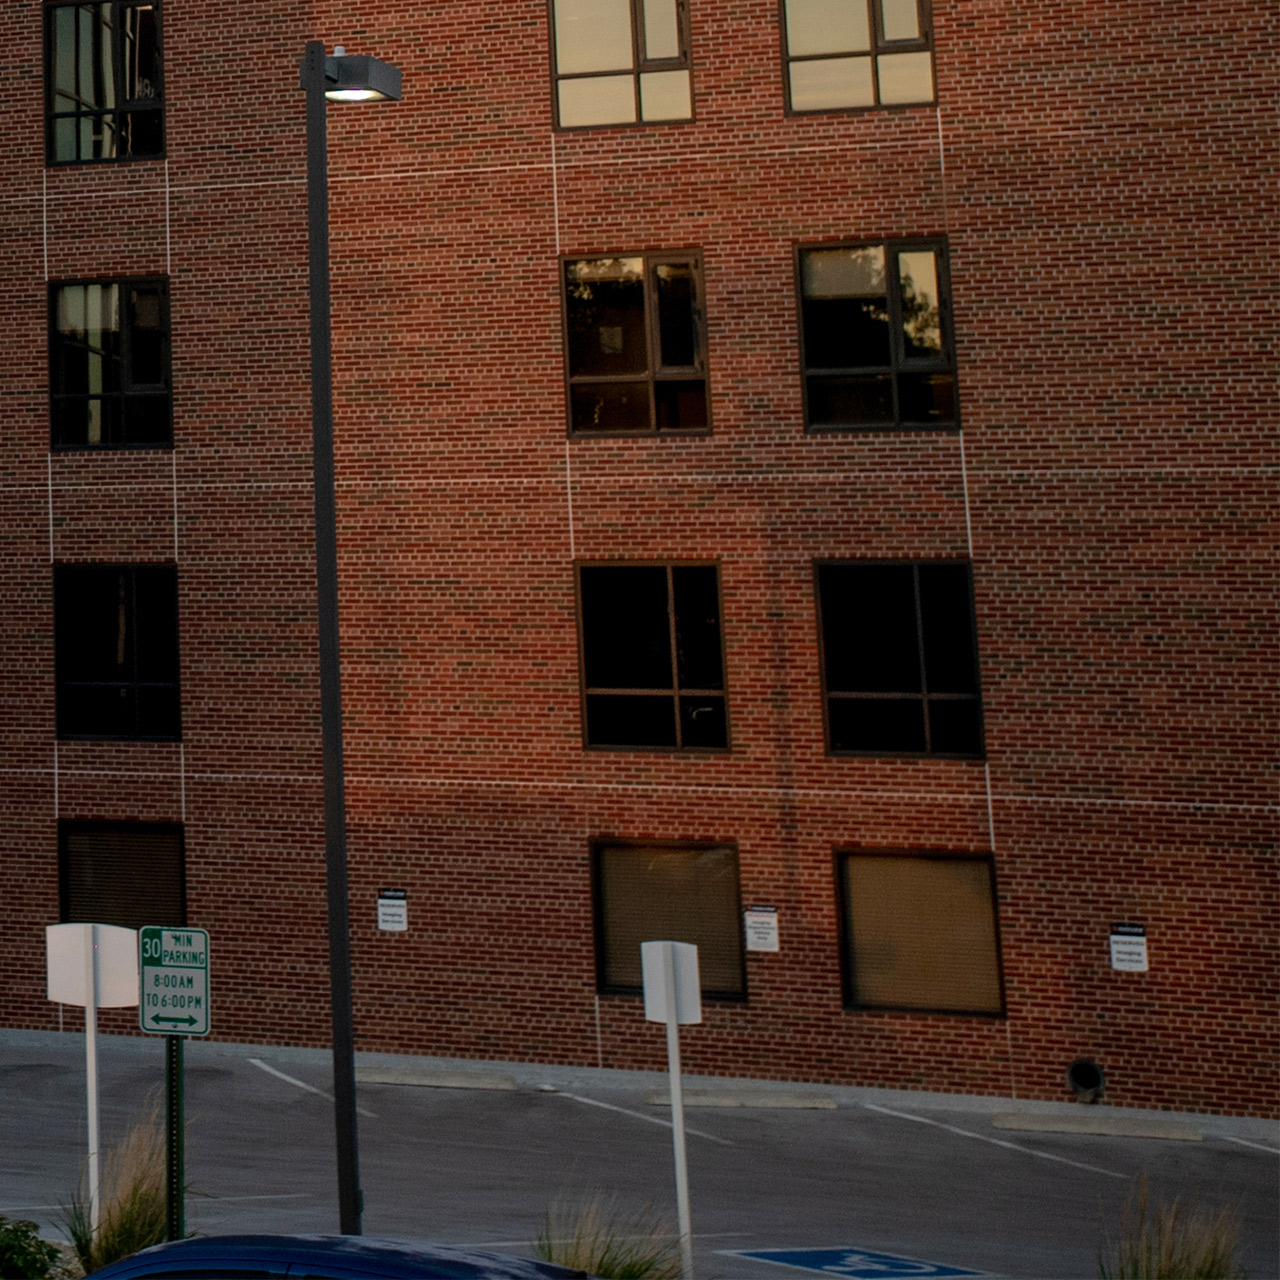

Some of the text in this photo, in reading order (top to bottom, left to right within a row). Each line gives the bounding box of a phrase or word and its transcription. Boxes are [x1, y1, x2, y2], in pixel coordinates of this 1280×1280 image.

[174, 934, 193, 947] MIN
[142, 938, 161, 959] 30
[163, 950, 205, 965] PARKING
[146, 993, 159, 1007] TO
